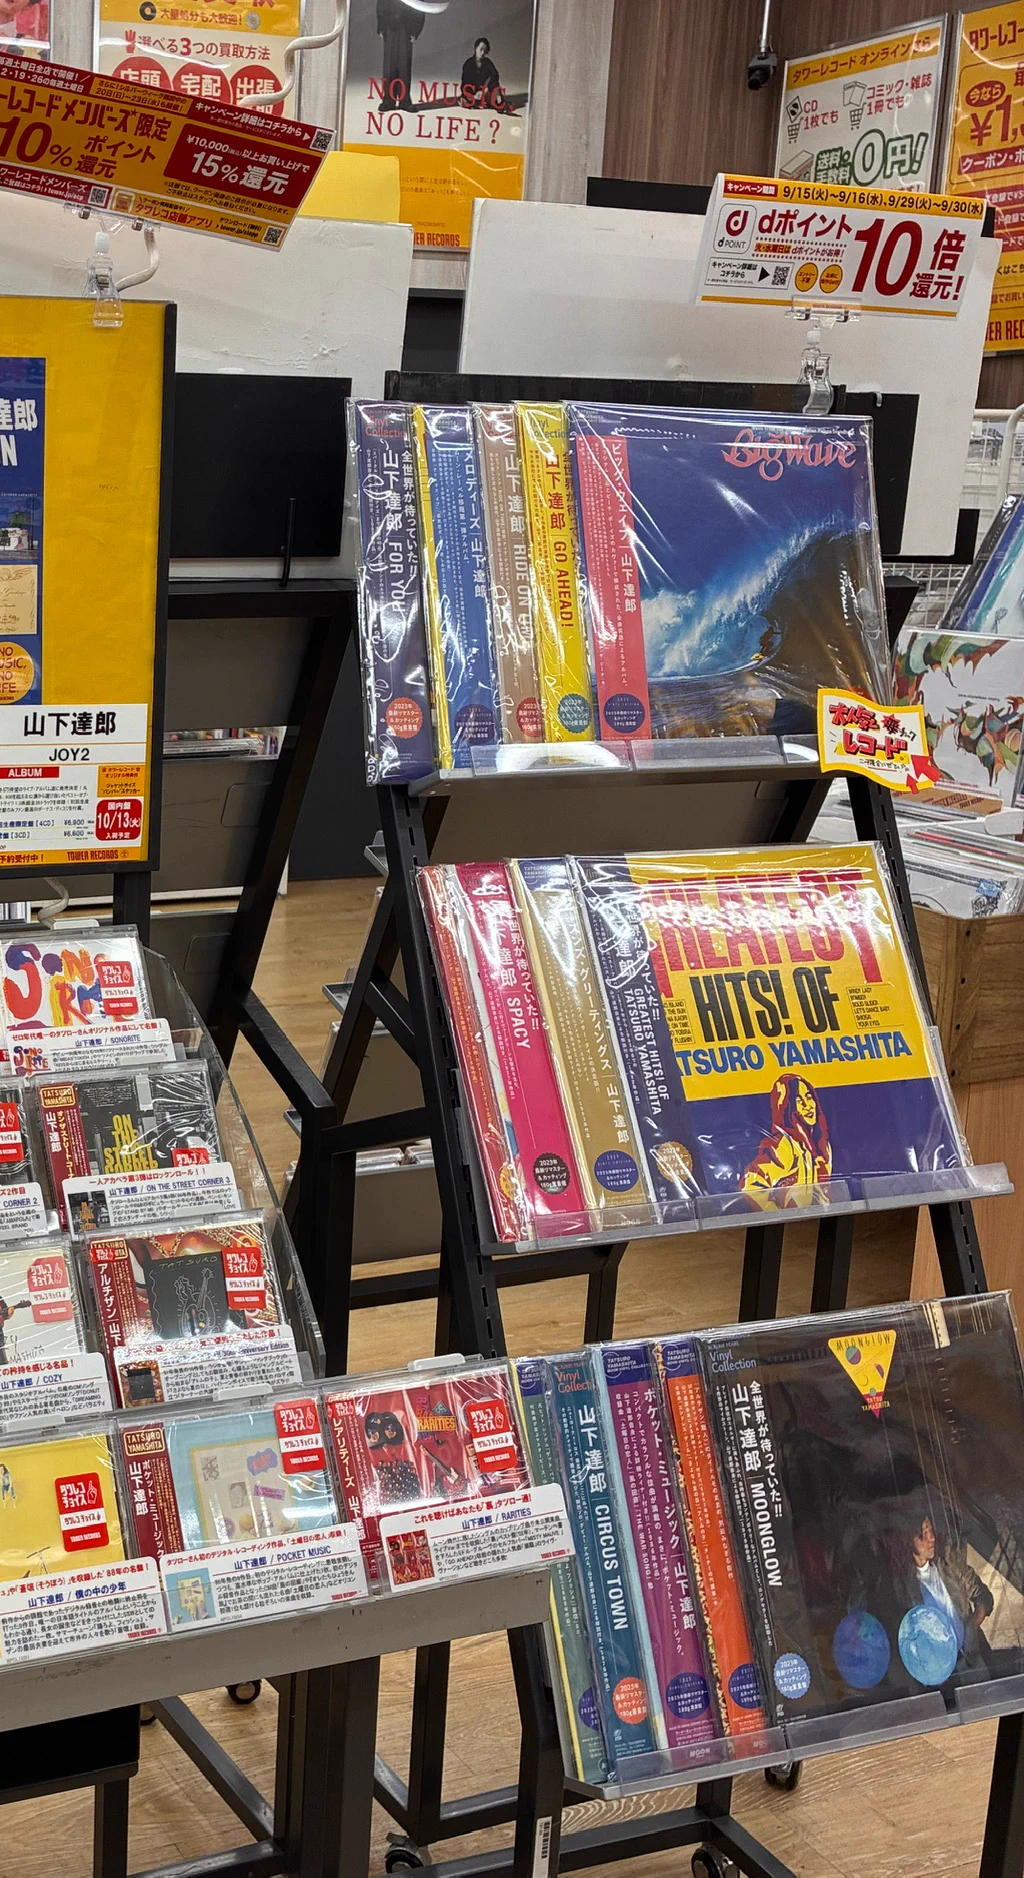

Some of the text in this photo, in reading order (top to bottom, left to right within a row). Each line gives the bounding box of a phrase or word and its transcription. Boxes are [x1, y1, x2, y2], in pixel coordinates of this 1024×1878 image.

[793, 55, 856, 83] タワーレコード
[181, 73, 221, 96] 宅配
[368, 77, 516, 114] NO MUSIC,
[969, 84, 1002, 103] 今なら
[195, 102, 302, 136] キャンペーン詳細はコチラから
[804, 100, 818, 114] CD
[366, 112, 404, 137] NO
[804, 111, 839, 130] 1枚でも
[84, 135, 156, 163] ポイント
[75, 154, 117, 178] 還元
[727, 182, 776, 195] キャンペーン期間
[427, 233, 460, 247] RECORDS
[851, 218, 924, 296] 10
[910, 272, 964, 301] 還元!
[383, 448, 403, 531] 山下達郎
[388, 541, 404, 576] FOR
[553, 541, 567, 564] GO
[471, 536, 488, 599] 山下達郎
[621, 552, 637, 613] 山下達郎
[555, 567, 575, 628] AHEAD!
[23, 711, 116, 737] 山下達郎
[49, 748, 90, 762] JOY2
[8, 769, 42, 777] ALBUM
[107, 802, 131, 810] 国内盤
[97, 812, 141, 829] 10/13(火)
[67, 851, 89, 861] TOWER
[90, 850, 118, 860] RECORDS
[689, 968, 792, 1043] HITS!
[792, 965, 841, 1034] OF
[506, 997, 531, 1049] SPACY
[75, 1035, 141, 1047] 山下達郎 SONORITE
[774, 1031, 913, 1068] YAMASHITA
[606, 1083, 630, 1143] 山下達郎
[45, 1112, 62, 1153] 山下達郎
[109, 1186, 138, 1196] 山下達郎
[173, 1180, 196, 1188] STREET
[198, 1178, 224, 1186] CORNER
[4, 1199, 30, 1208] CORNER
[33, 1197, 38, 1205] 2
[98, 1262, 116, 1318] アルチザン
[836, 1330, 893, 1350] MOONGLOW
[709, 1349, 733, 1362] Vinyl
[712, 1358, 757, 1373] Collection
[1, 1373, 63, 1390] 山下達郎 COZY
[416, 1416, 457, 1433] RARITIES
[126, 1431, 162, 1444] TATSURO
[128, 1440, 164, 1453] YAMASHITA
[59, 1481, 87, 1497] タワレコ
[129, 1461, 149, 1516] 山下達郎
[732, 1382, 783, 1587] 山下達郎 MOONGLOW
[62, 1494, 88, 1509] チョイス
[644, 1387, 696, 1630] ポケット・ミュージック 山下達郎
[462, 1508, 532, 1530] 山下達郎 RARITIES
[594, 1503, 619, 1572] CIRCUS
[234, 1545, 332, 1570] 山下達郎 POCKET MUSIC
[28, 1582, 127, 1608] 山下達郎 僕の中の少年
[606, 1576, 629, 1632] TOWN
